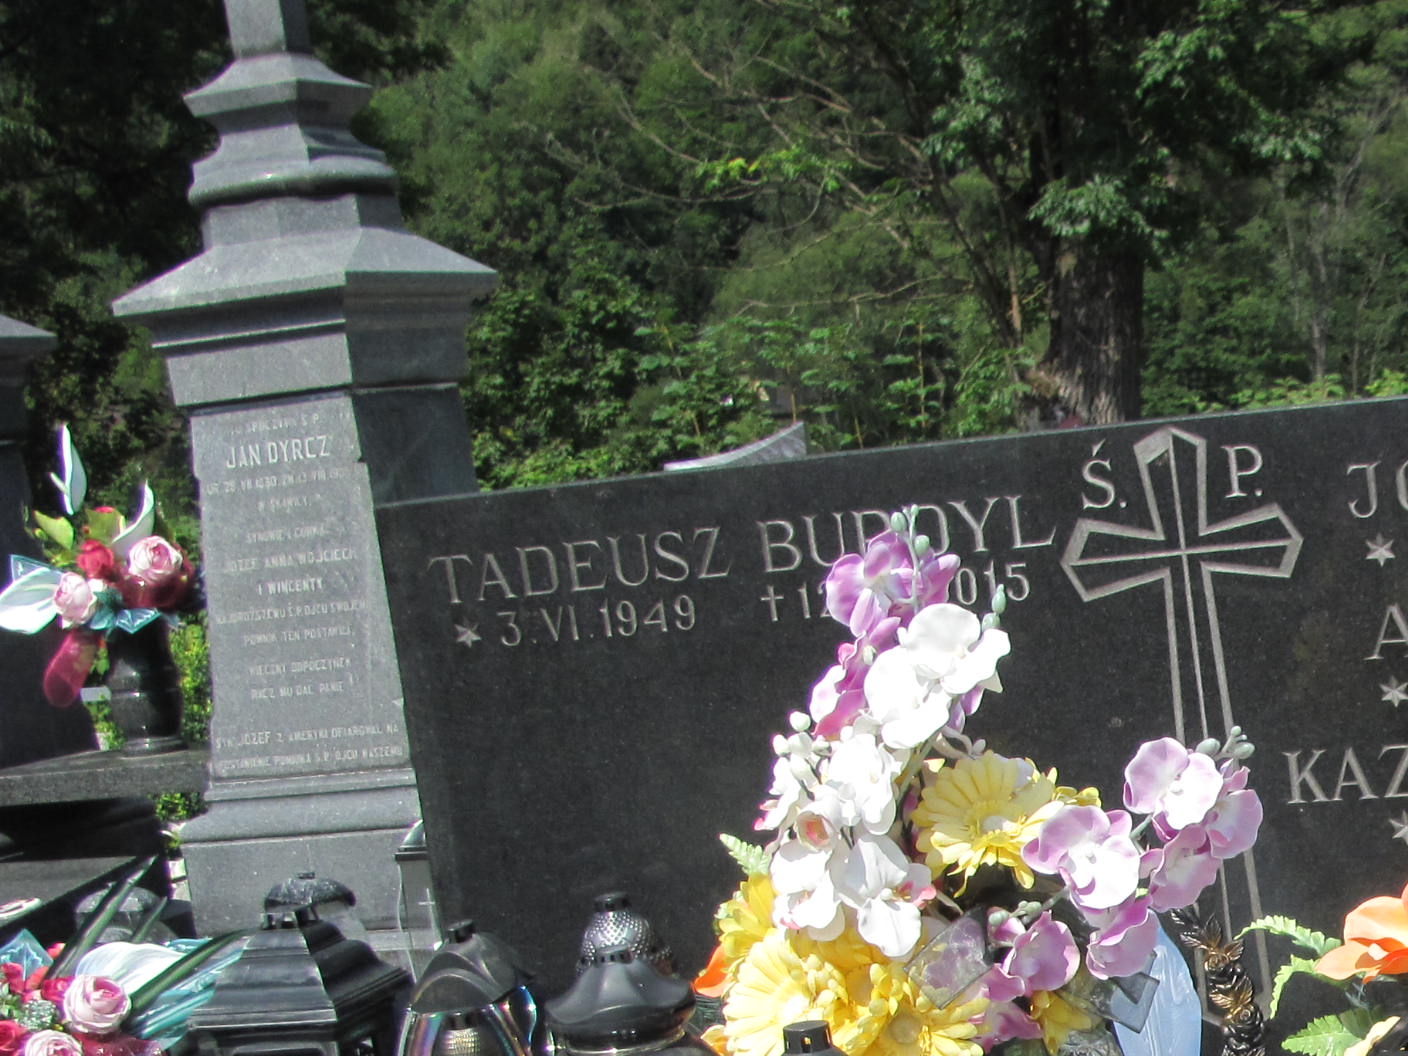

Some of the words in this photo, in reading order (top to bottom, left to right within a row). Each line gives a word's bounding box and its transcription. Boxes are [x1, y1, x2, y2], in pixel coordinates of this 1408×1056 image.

[225, 443, 262, 469] JAN
[267, 434, 332, 464] DYRCZ
[427, 527, 732, 603] TADEUSZ
[267, 577, 324, 595] WINCENTY
